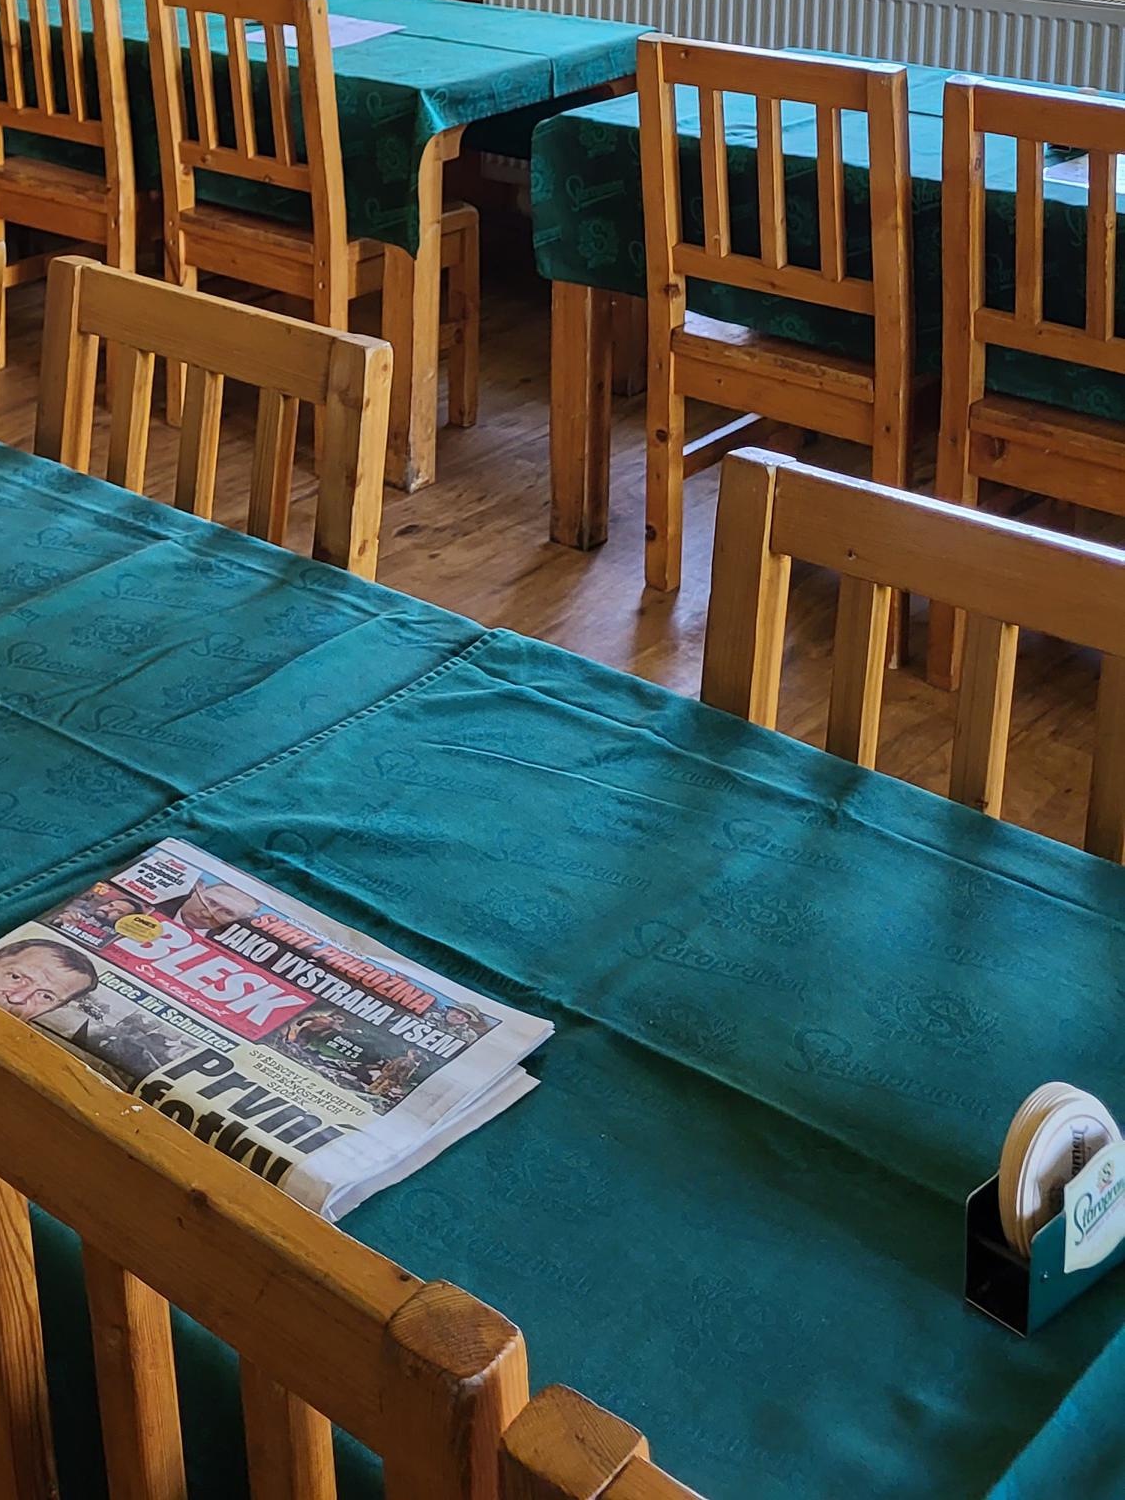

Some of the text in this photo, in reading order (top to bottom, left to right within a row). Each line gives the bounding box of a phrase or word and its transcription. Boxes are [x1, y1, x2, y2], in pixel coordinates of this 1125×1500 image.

[98, 972, 140, 999] Herec
[161, 1008, 236, 1052] Schmitzer
[113, 921, 307, 1026] BLESK
[213, 923, 278, 963] JAKO
[271, 952, 394, 1026] VÝSTRAHA
[388, 1013, 467, 1059] VŠEM
[251, 912, 322, 949] SMRT
[313, 945, 436, 1016] PRIGOŽINA
[162, 1049, 362, 1154] První
[316, 1088, 365, 1116] ARCHIVU
